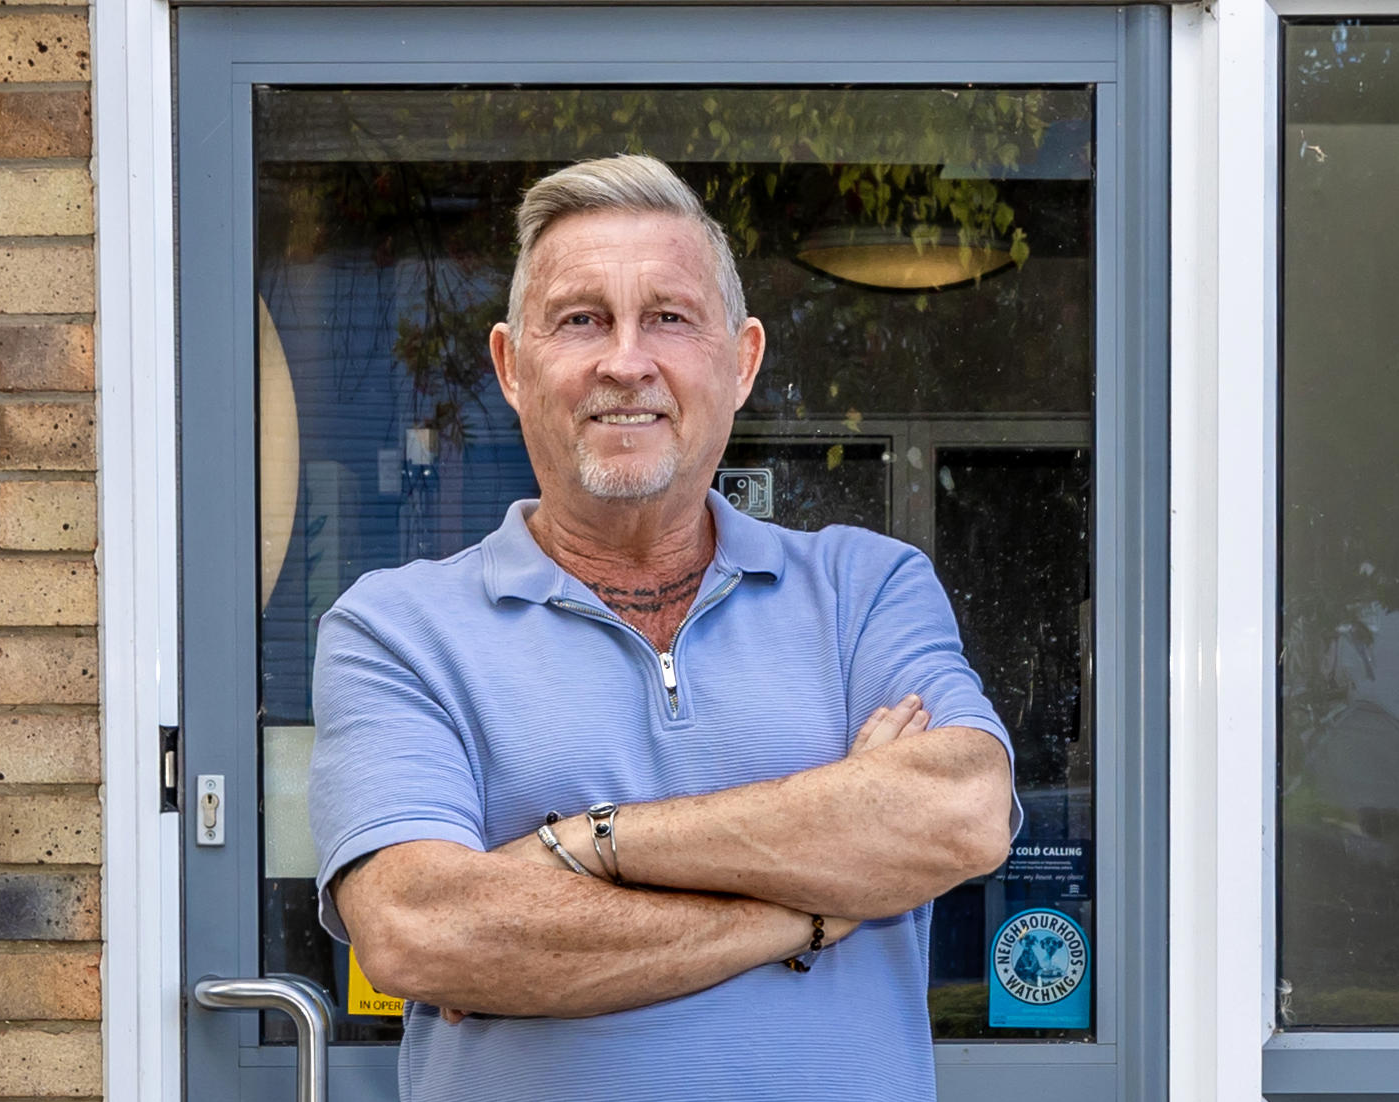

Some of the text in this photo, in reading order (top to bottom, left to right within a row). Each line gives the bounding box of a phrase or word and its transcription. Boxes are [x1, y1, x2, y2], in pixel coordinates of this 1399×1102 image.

[1016, 847, 1041, 856] COLD
[1042, 847, 1083, 856] CALLING
[997, 915, 1084, 966] NEIGHBOURHOODS
[1005, 974, 1076, 1002] WATCHING
[359, 1000, 370, 1009] IN
